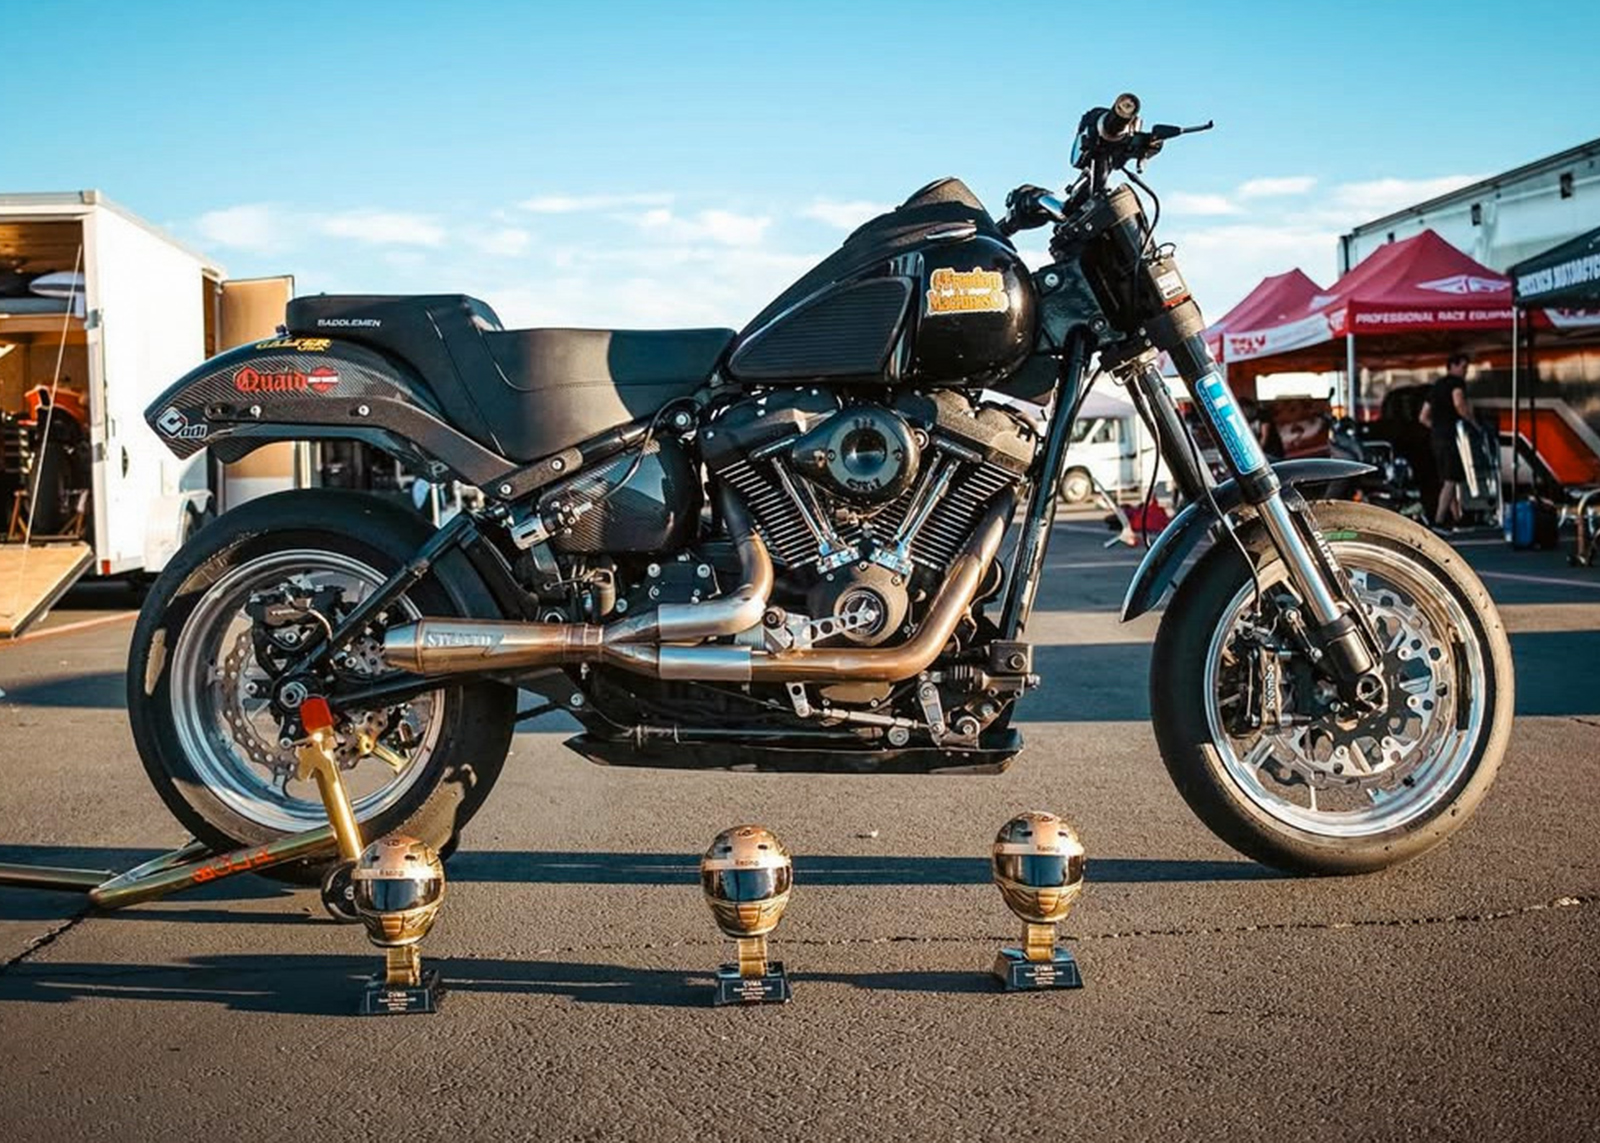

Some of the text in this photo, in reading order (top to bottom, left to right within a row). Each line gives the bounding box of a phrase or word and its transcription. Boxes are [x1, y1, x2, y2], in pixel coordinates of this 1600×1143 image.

[1355, 310, 1526, 324] PROFESSIONAL RACE EQUIPMT
[233, 366, 308, 393] Quaid
[1265, 663, 1276, 710] brembo
